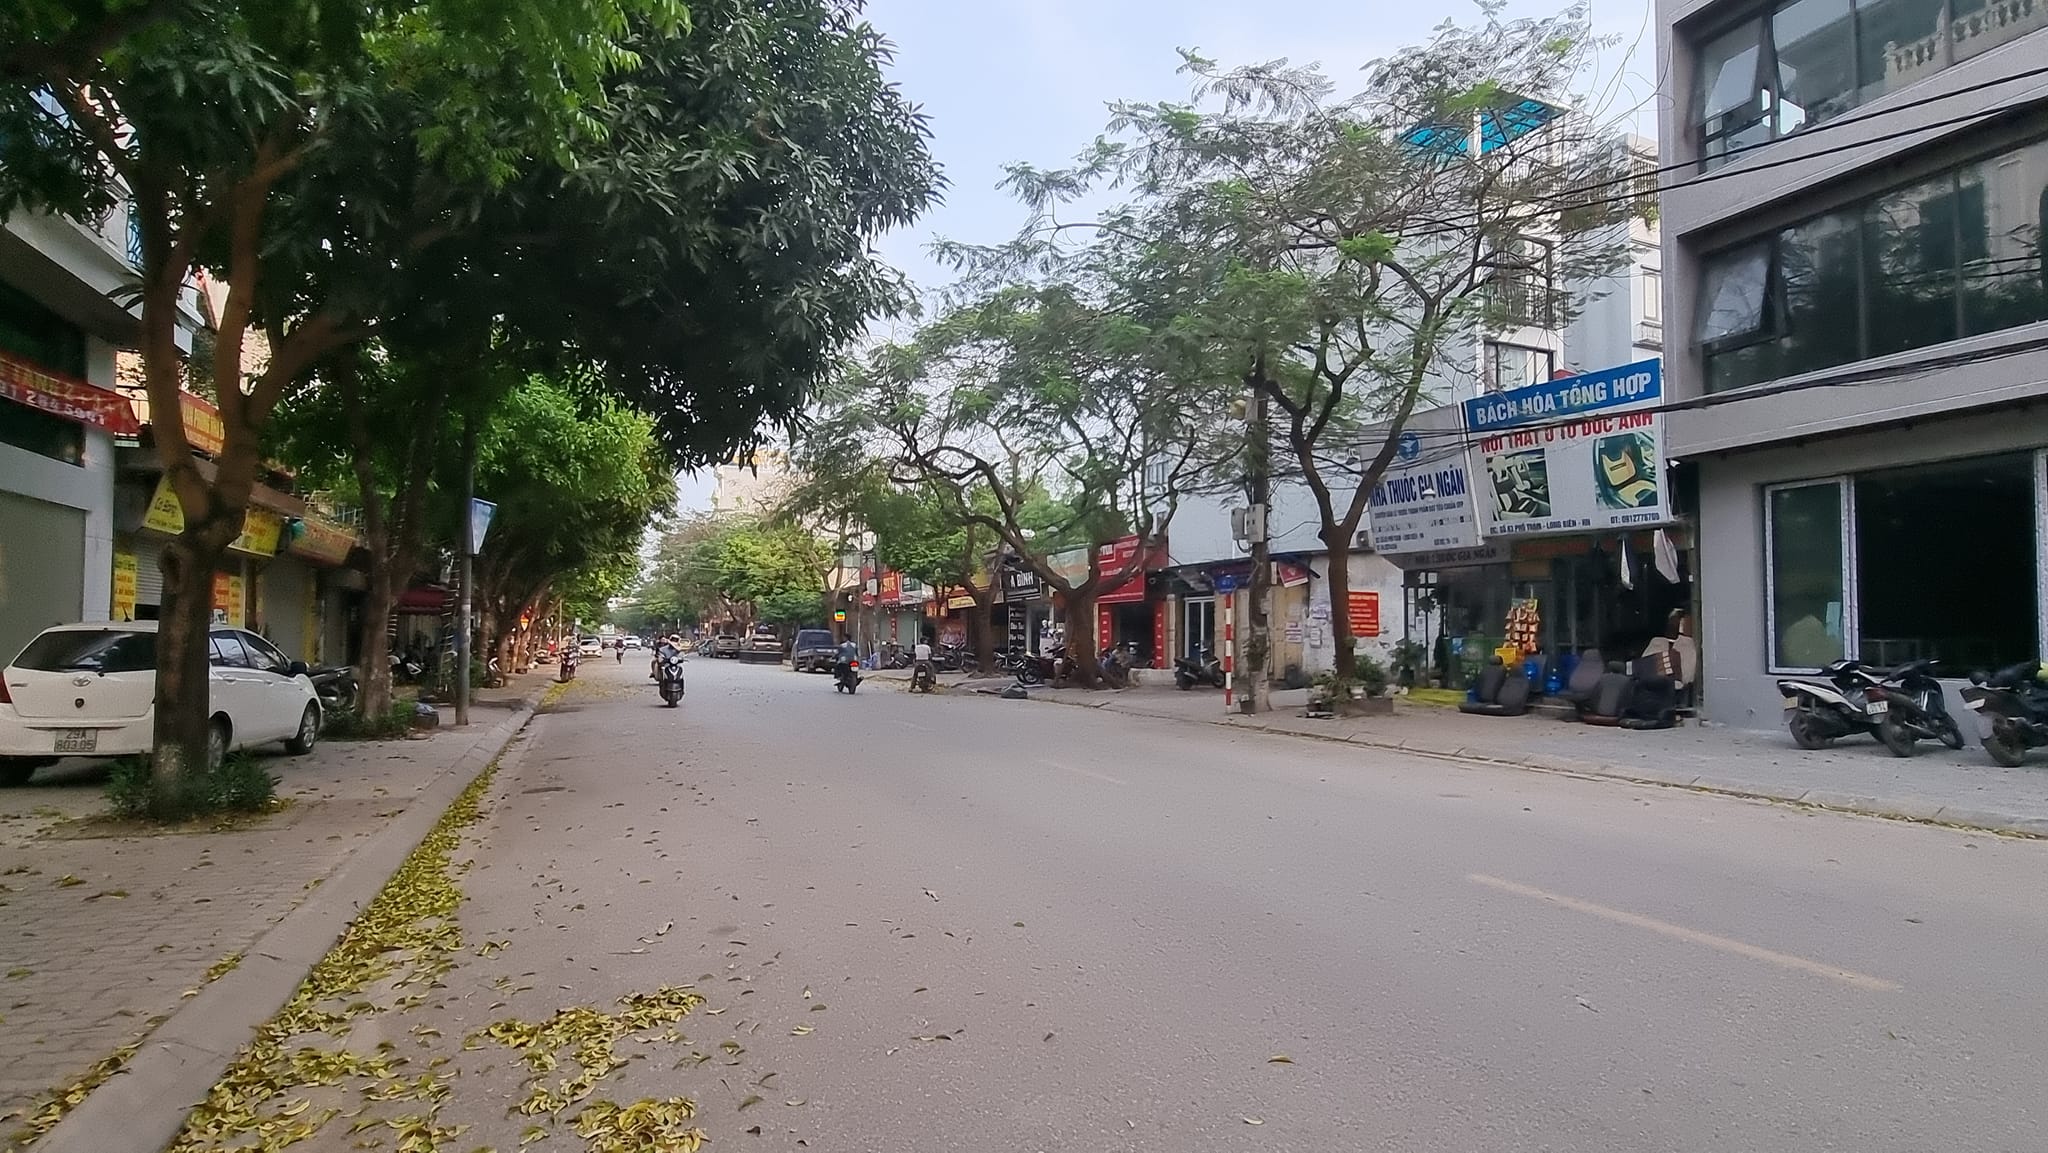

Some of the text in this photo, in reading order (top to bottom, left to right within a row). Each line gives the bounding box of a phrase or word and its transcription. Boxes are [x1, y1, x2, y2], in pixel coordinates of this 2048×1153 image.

[1476, 372, 1652, 425] BÁCH HÓA TỔNG HỢP
[66, 729, 87, 739] 29A
